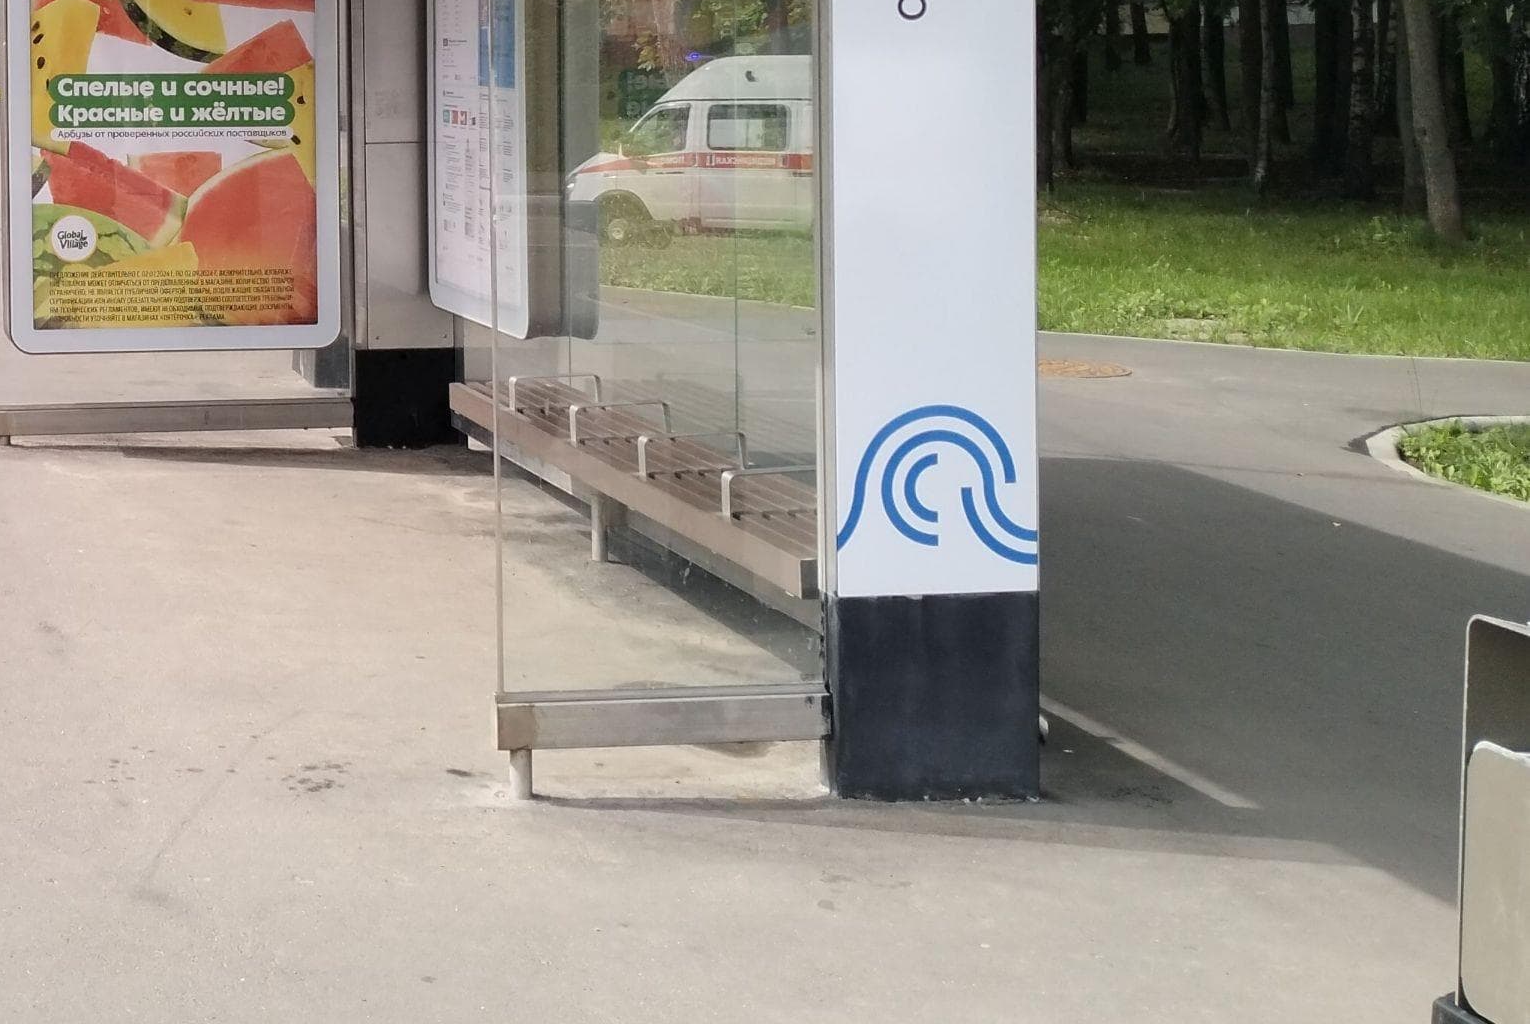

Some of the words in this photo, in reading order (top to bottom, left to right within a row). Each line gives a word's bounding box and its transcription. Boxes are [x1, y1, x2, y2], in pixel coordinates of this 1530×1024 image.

[57, 78, 154, 97] Спелые
[161, 81, 177, 96] и
[184, 77, 285, 96] сочные!
[57, 104, 163, 126] Красные
[170, 107, 184, 121] и
[191, 101, 286, 122] жёлтые
[57, 130, 93, 140] Арбузы
[107, 131, 170, 139] проверенных
[171, 129, 224, 139] российских
[226, 130, 287, 139] поставщиков
[57, 230, 84, 240] Global
